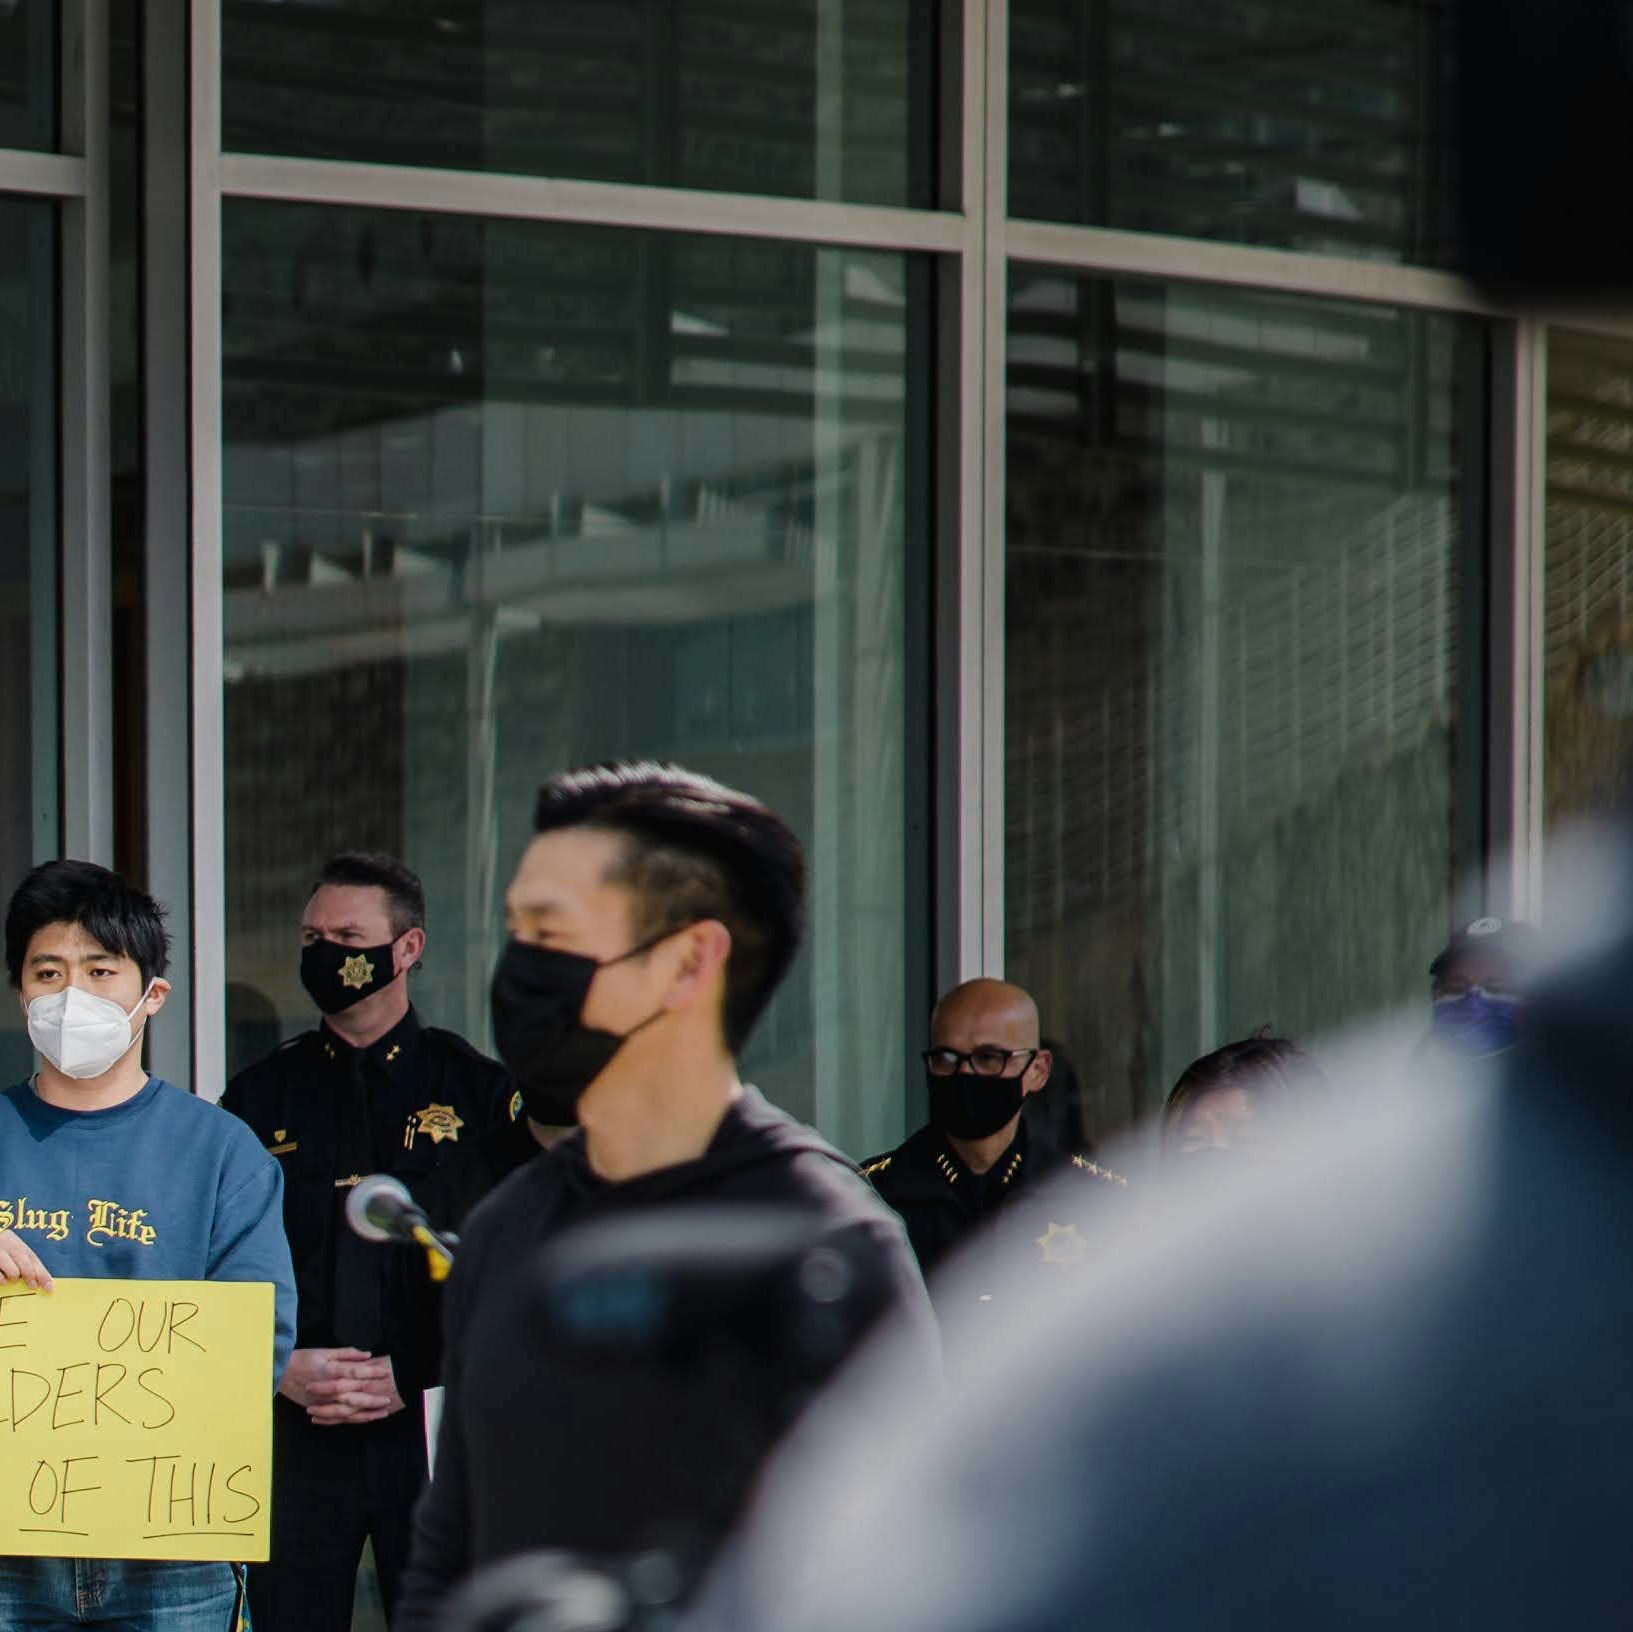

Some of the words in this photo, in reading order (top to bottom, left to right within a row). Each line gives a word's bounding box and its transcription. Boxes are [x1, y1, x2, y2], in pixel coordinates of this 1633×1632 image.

[87, 1199, 157, 1247] Life
[97, 1298, 207, 1353] OUR
[28, 1456, 102, 1523] OF
[125, 1455, 261, 1526] THIS
